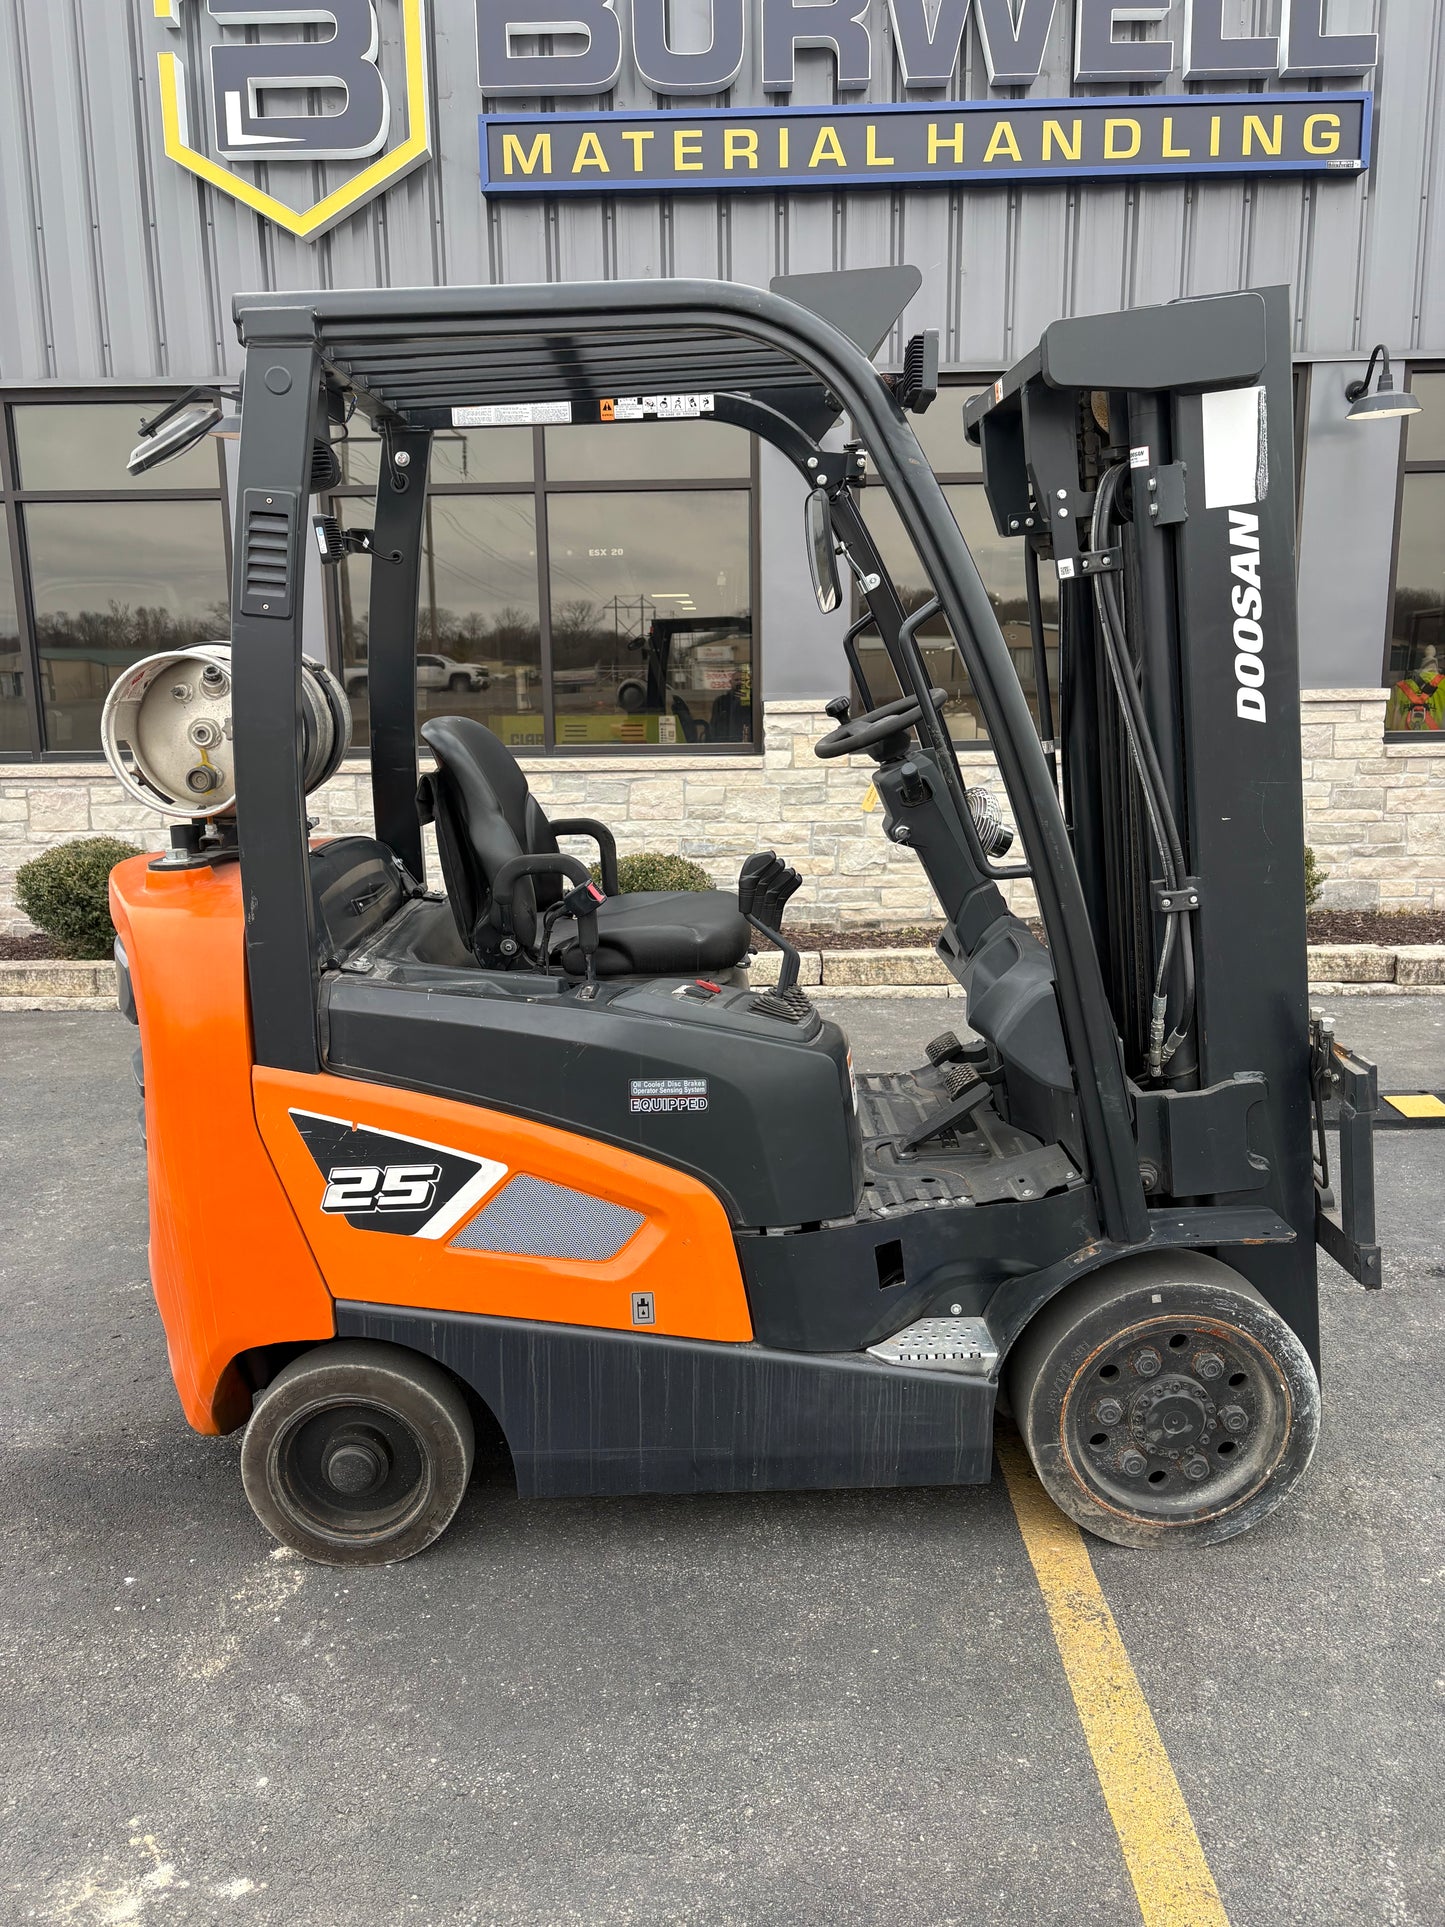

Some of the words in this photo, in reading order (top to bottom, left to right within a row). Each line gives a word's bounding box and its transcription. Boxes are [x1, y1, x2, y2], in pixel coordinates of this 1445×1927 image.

[502, 124, 895, 176] MATERIAL
[927, 113, 1342, 165] HANDLING
[588, 548, 607, 557] ESX
[610, 547, 624, 556] 20
[1228, 509, 1267, 724] DOOSAN
[633, 1087, 658, 1095] Operator
[659, 1086, 683, 1094] Sensing
[683, 1086, 706, 1094] System
[643, 1080, 665, 1088] Cooled
[683, 1079, 706, 1087] Brakes
[630, 1097, 708, 1112] EQUIPPED
[320, 1163, 443, 1215] 25
